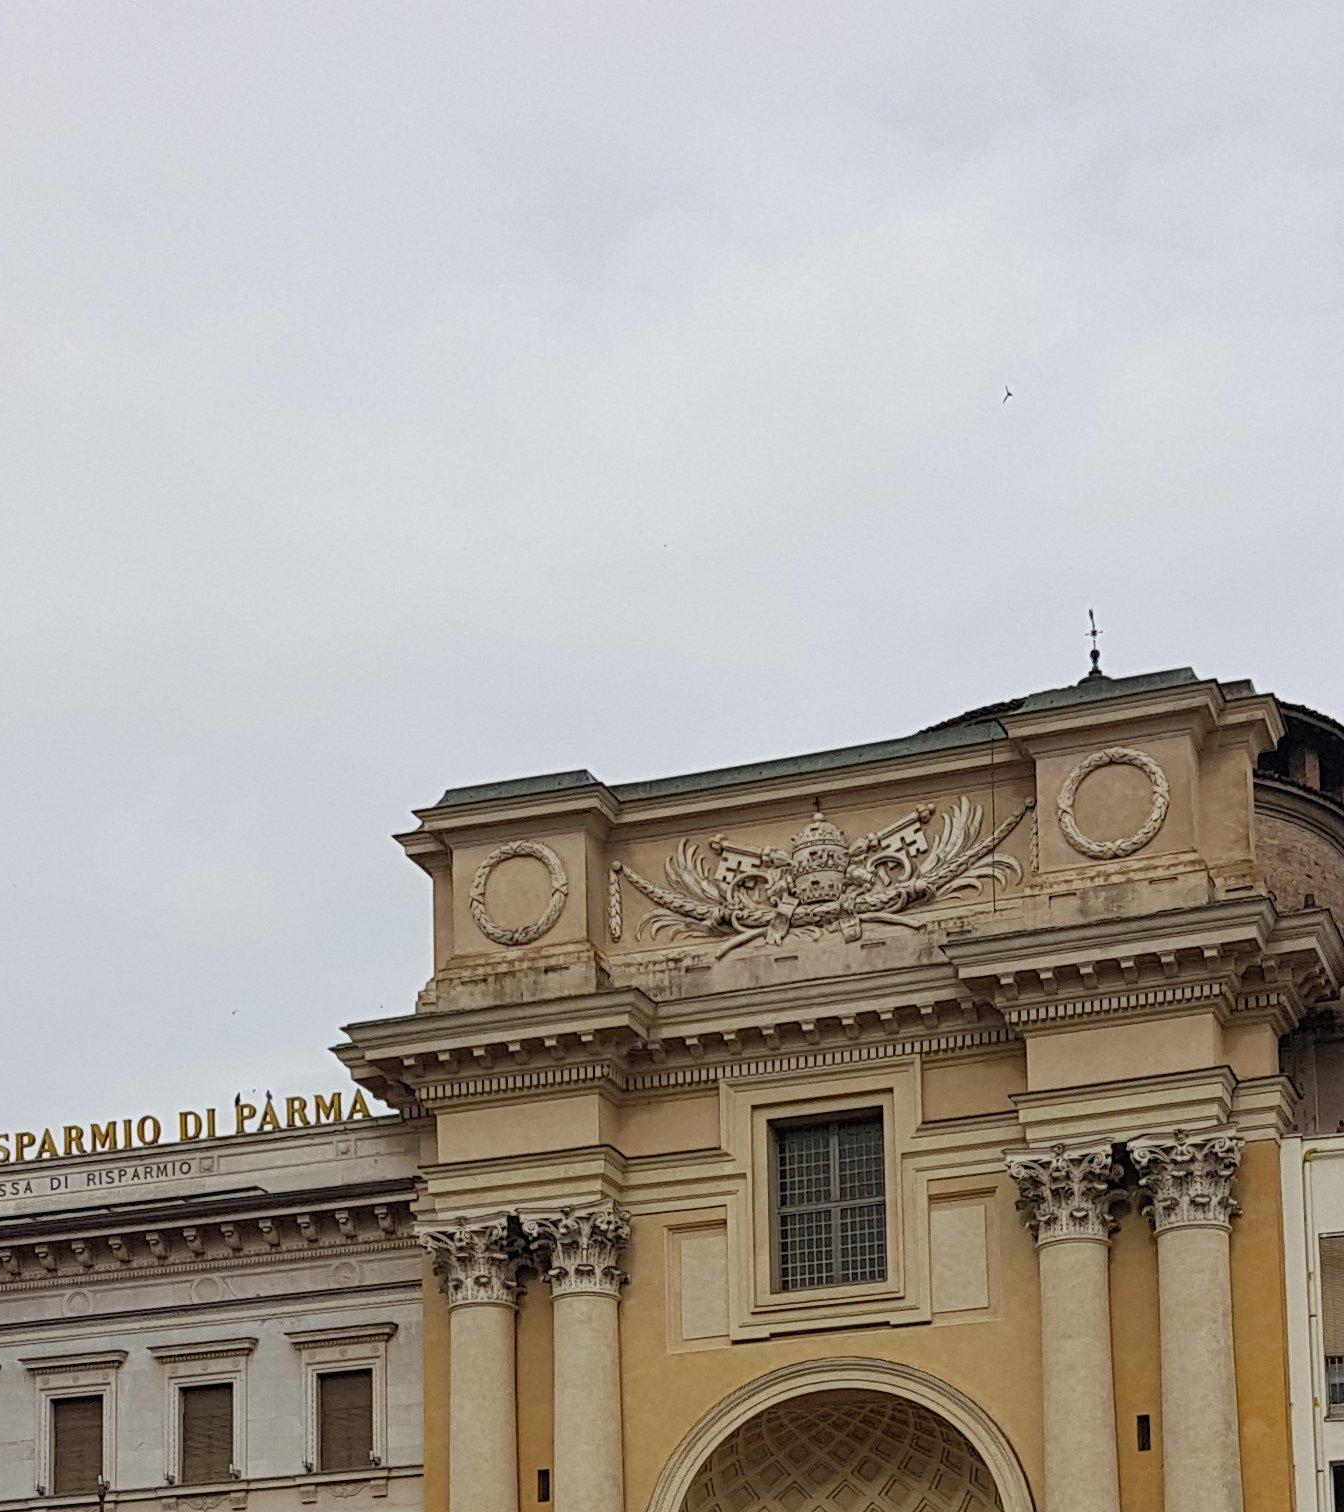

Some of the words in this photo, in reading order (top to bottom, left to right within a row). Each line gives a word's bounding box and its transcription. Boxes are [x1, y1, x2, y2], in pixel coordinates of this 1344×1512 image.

[179, 1107, 217, 1141] DI
[235, 1088, 373, 1134] PARMA
[50, 1175, 69, 1191] DI
[87, 1161, 192, 1187] RISPARMIO
